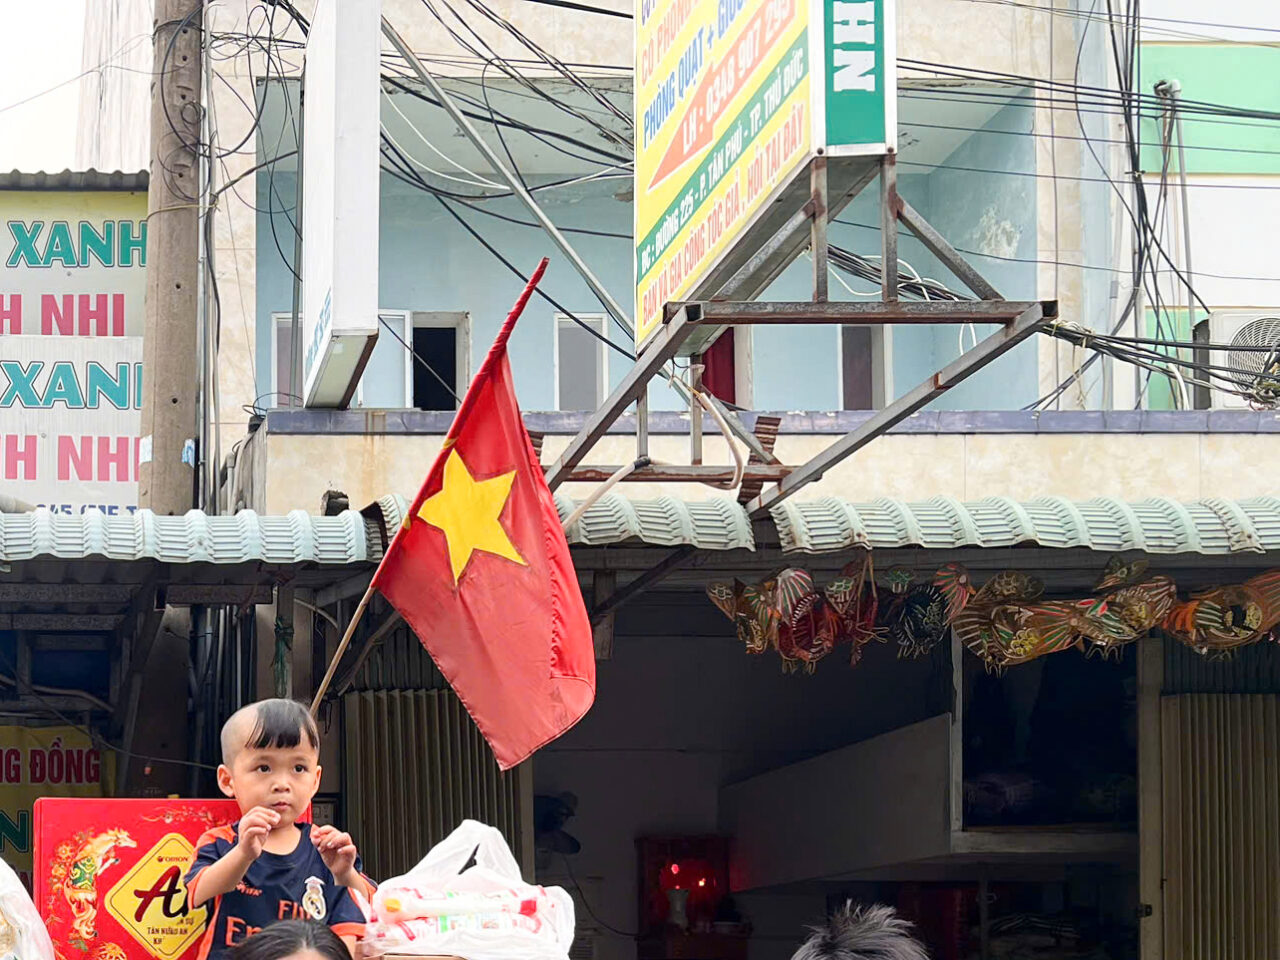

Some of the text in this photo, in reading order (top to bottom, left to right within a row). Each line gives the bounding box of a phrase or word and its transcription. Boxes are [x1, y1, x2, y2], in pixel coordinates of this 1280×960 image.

[644, 71, 675, 149] PHÒNG
[678, 26, 704, 99] QUẠT
[6, 220, 148, 268] XANH
[41, 293, 125, 337] NHI
[29, 737, 101, 785] ĐỒNG
